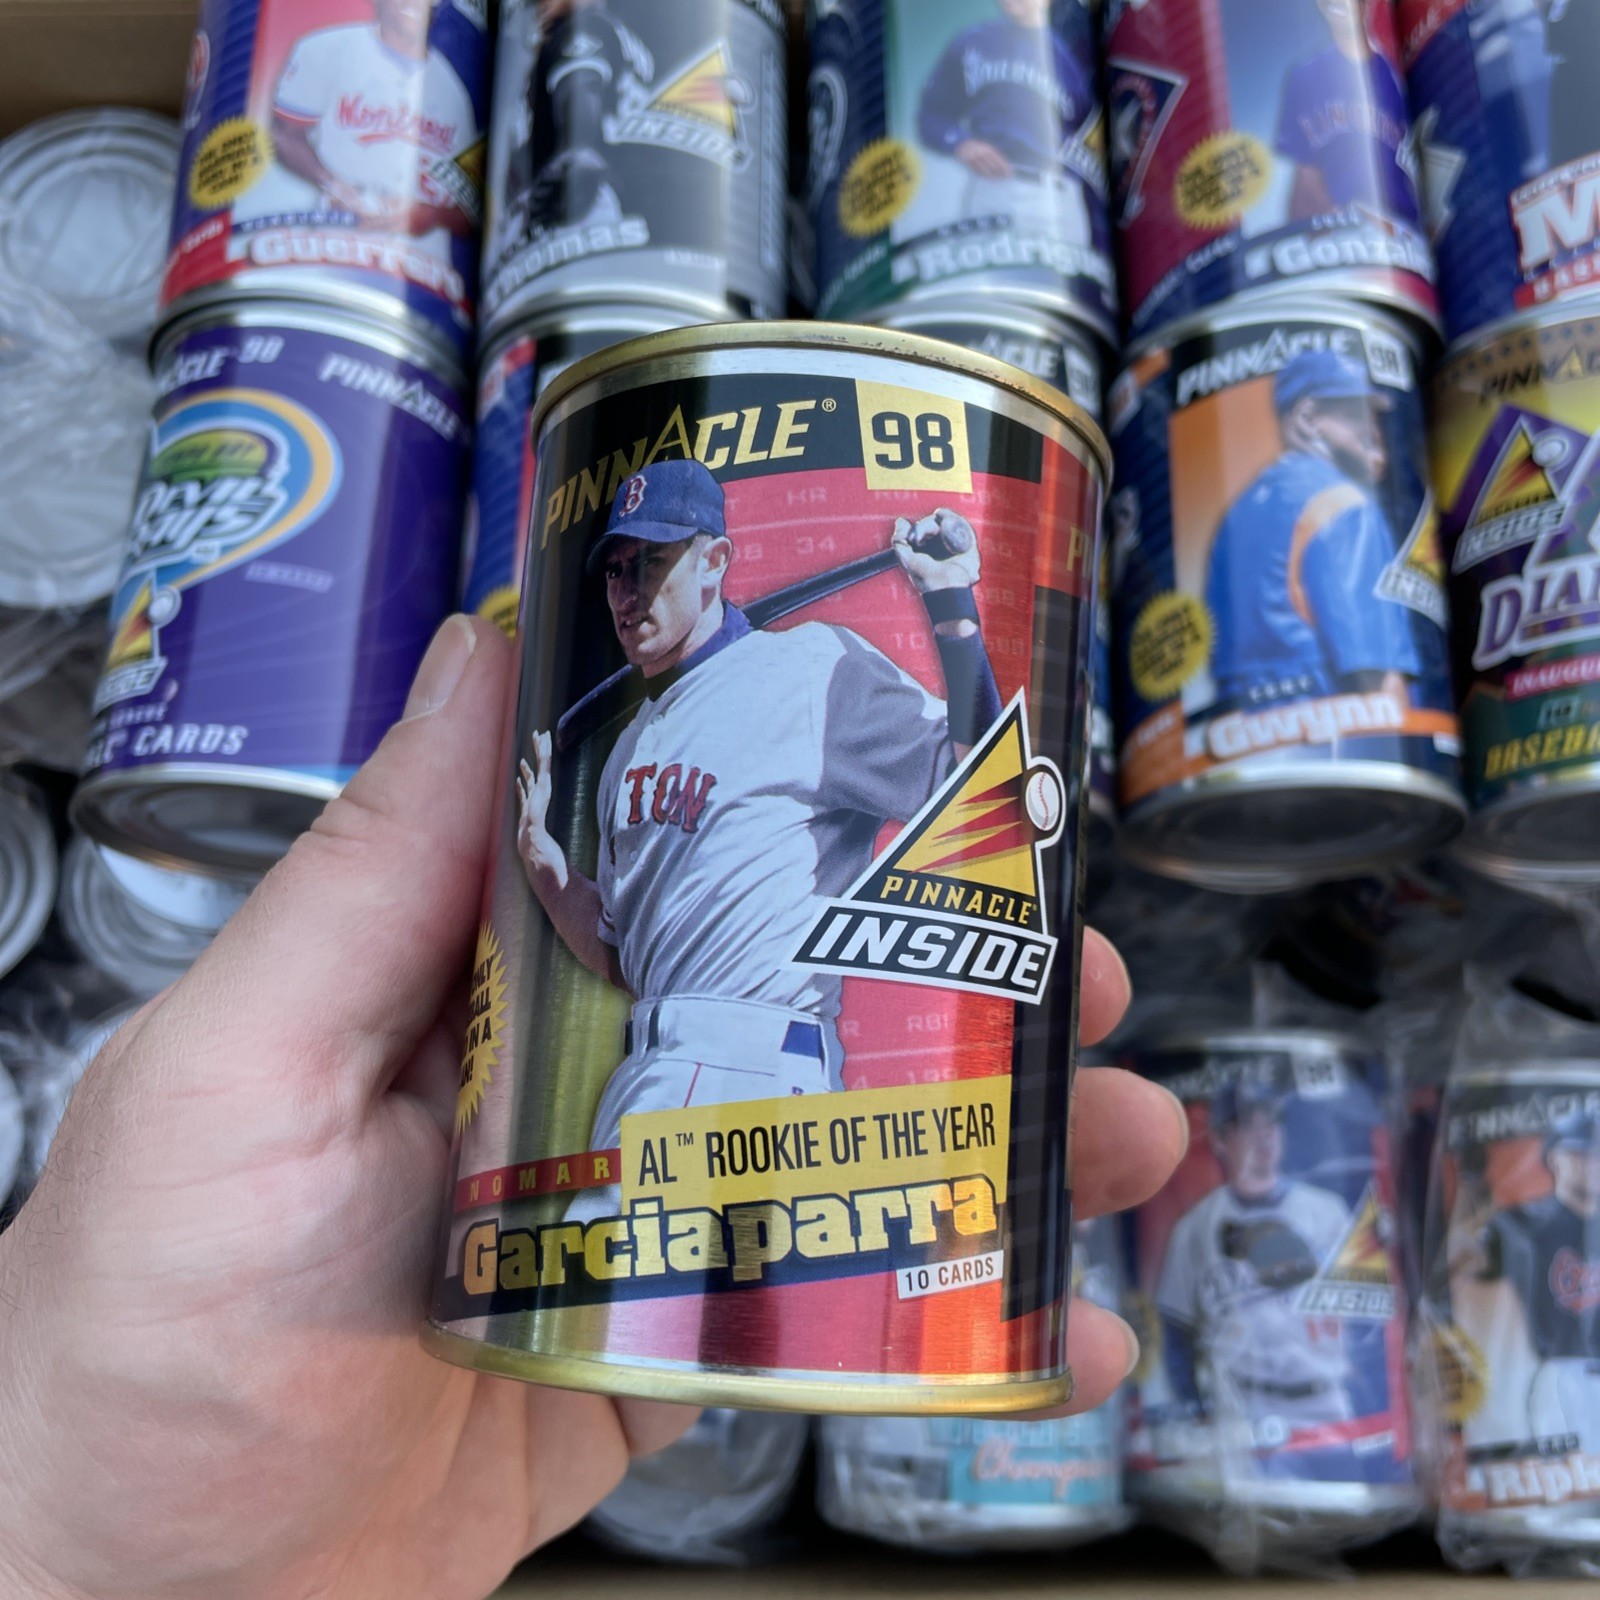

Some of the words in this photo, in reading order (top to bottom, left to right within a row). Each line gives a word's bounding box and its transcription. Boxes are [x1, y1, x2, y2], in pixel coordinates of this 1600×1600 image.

[870, 412, 955, 473] 98
[133, 722, 249, 757] CARDS
[1206, 692, 1404, 760] Gwynn
[879, 875, 1037, 926] PINNACLE
[808, 912, 1047, 990] INSIDE
[705, 1120, 822, 1179] ROOKIE
[829, 1115, 867, 1166] OF
[872, 1109, 928, 1160] THE
[931, 1102, 996, 1153] YEAR
[469, 1156, 612, 1202] NOMAR
[462, 1174, 998, 1297] Garciaparra
[904, 1269, 930, 1292] 10
[938, 1256, 995, 1286] CARDS
